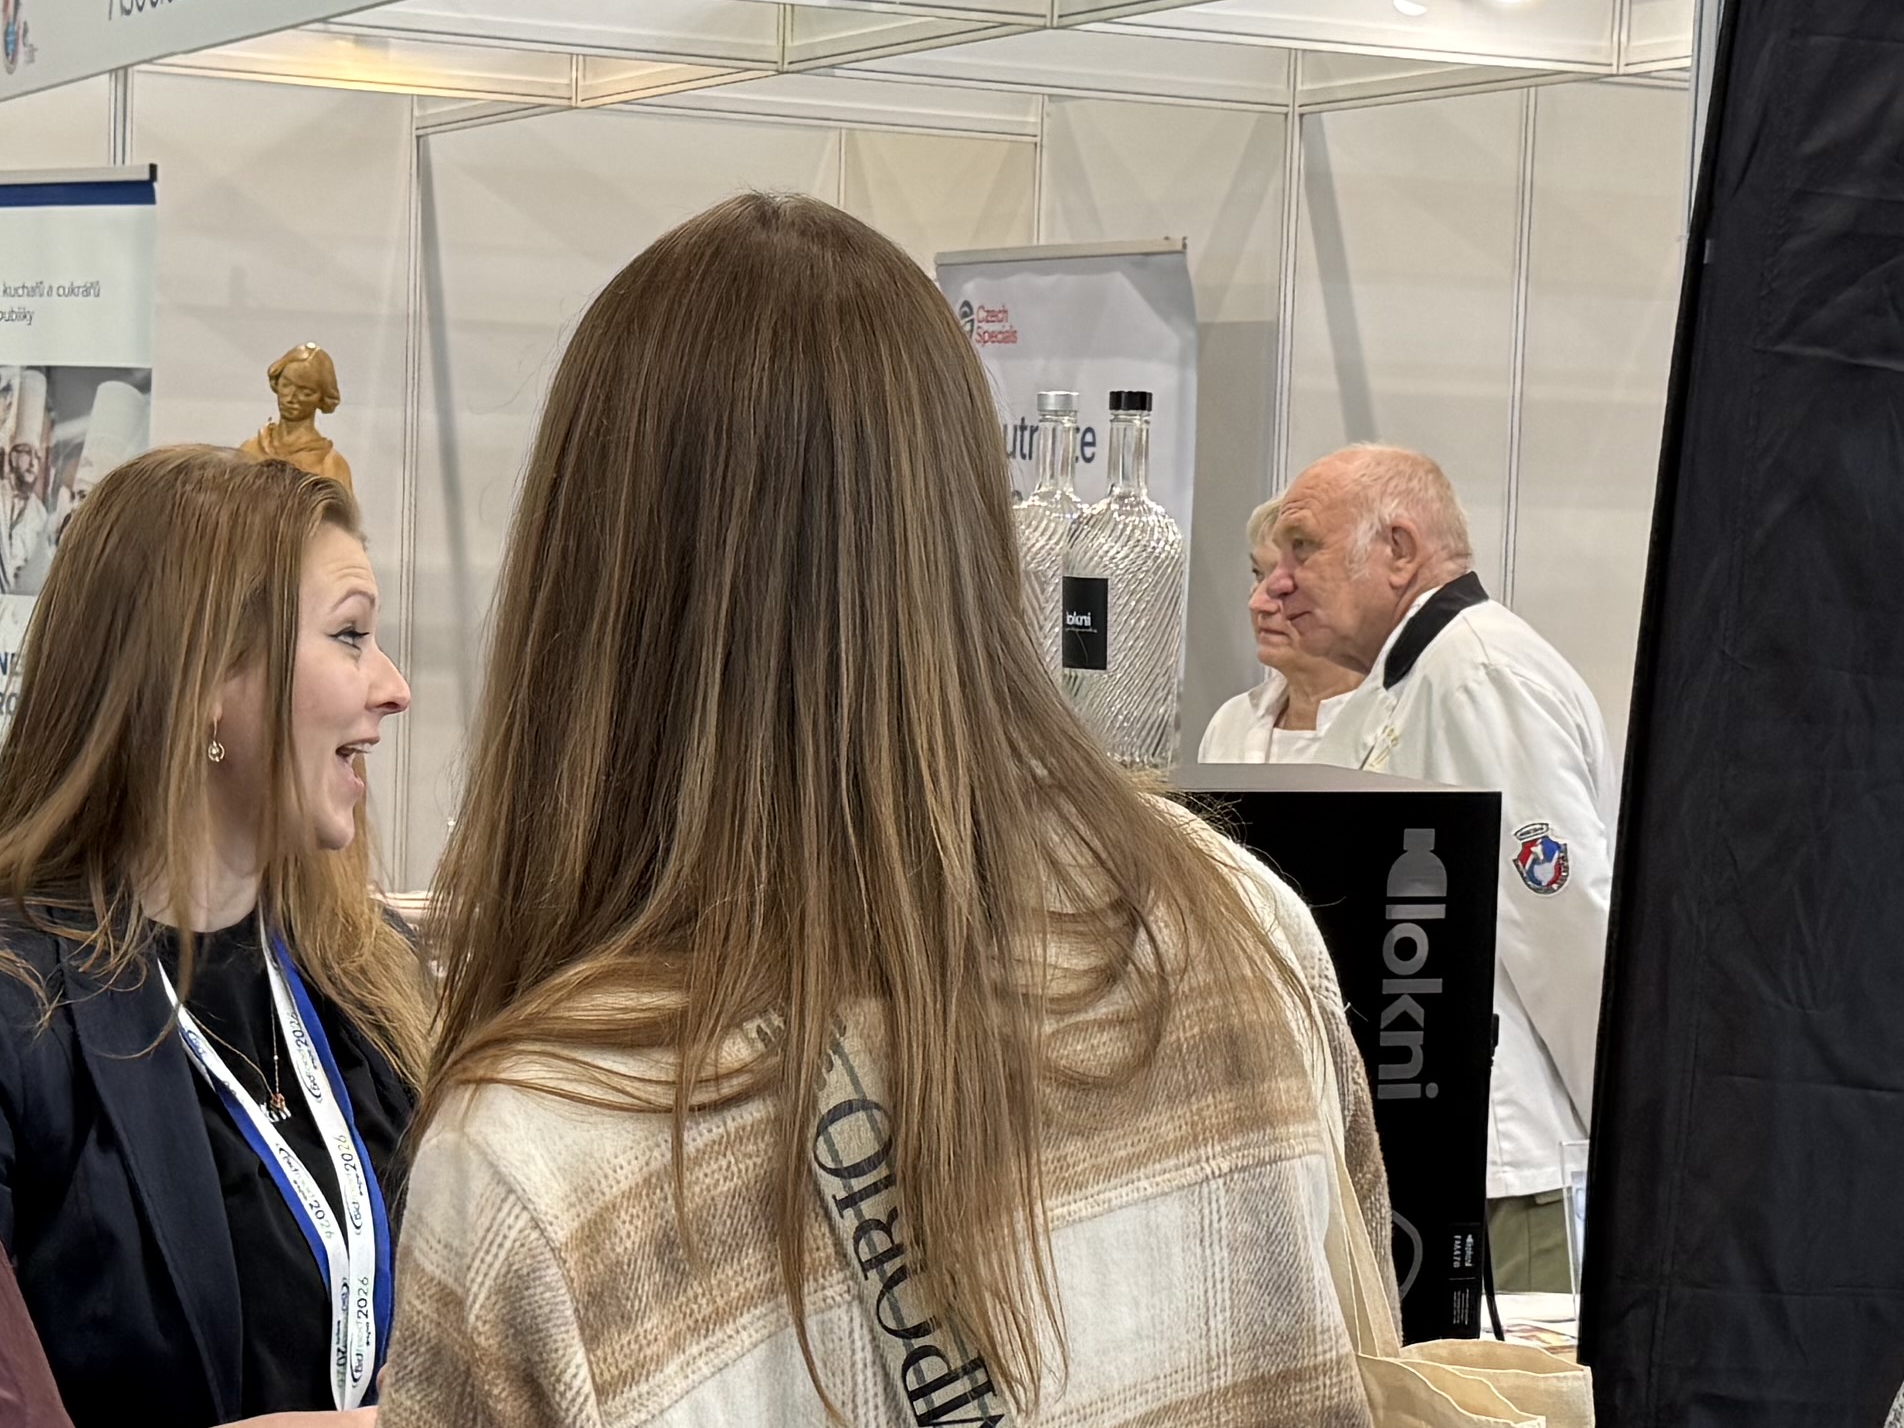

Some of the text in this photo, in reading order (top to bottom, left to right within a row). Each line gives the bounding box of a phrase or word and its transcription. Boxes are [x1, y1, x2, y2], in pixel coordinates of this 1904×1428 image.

[976, 305, 1008, 323] Czech
[975, 325, 1018, 347] Specials
[1377, 903, 1447, 1100] lokni
[333, 1134, 357, 1173] 2026
[308, 1199, 336, 1240] 2026
[356, 1276, 369, 1320] 2026
